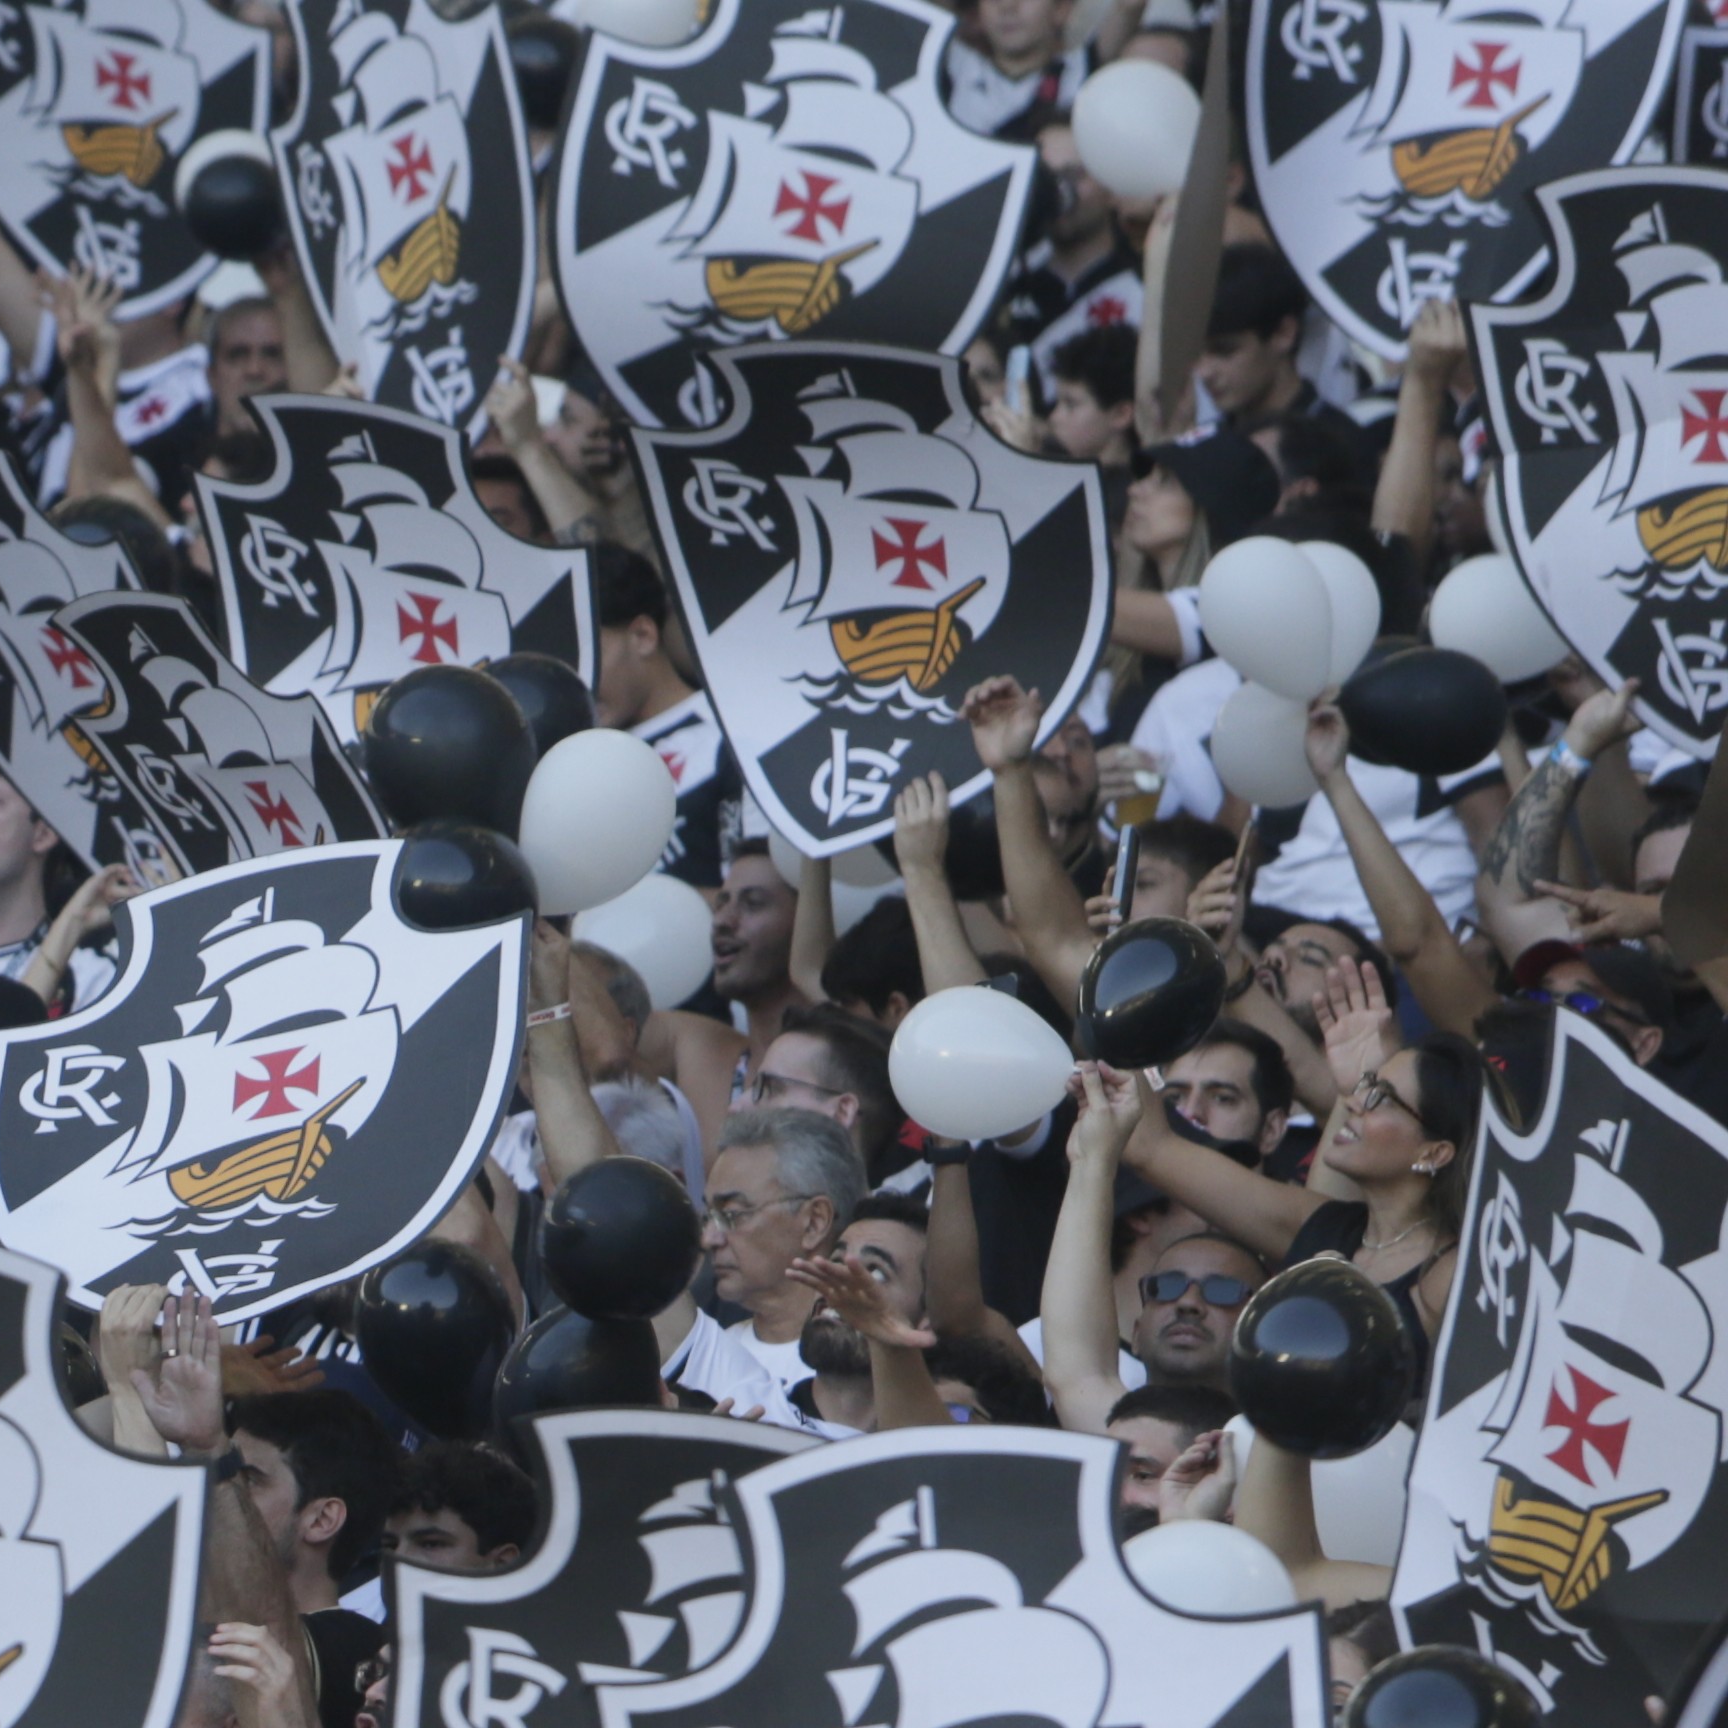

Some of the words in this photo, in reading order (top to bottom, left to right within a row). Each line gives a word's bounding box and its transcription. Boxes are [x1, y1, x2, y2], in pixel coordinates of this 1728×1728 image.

[1280, 0, 1364, 83] CR
[603, 74, 697, 190] CR
[1377, 235, 1467, 329] VG
[1514, 337, 1604, 445] CR
[683, 456, 778, 552] CR
[240, 511, 320, 618] CR
[1651, 618, 1728, 724] VG
[125, 743, 216, 831] CR
[809, 727, 913, 827] VG
[18, 1044, 127, 1134] CR
[167, 1237, 287, 1303] VG
[1478, 1169, 1529, 1349] CR
